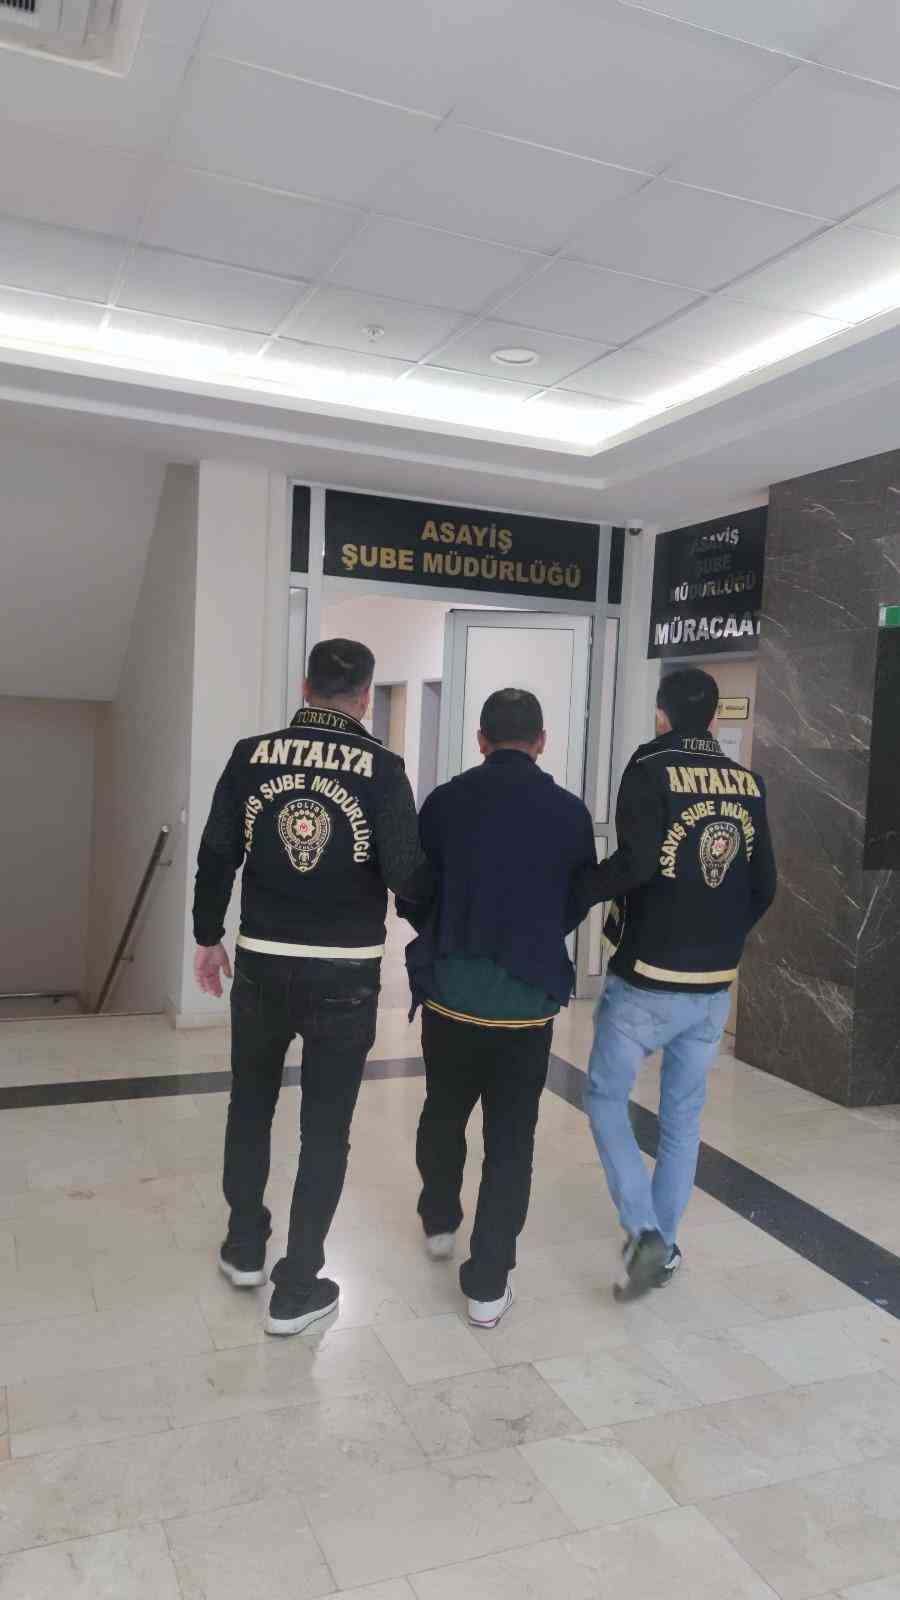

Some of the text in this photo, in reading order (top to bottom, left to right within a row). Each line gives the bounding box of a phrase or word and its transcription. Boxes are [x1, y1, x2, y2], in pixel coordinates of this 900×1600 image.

[420, 520, 513, 554] ASAYİŞ
[341, 543, 582, 588] ŞUBE MÜDÜRLÜĞÜ
[295, 710, 348, 730] TÜRKİYE
[250, 739, 374, 778] ANTALYA
[666, 767, 761, 798] ANTALYA
[259, 773, 306, 802] ŞUBE
[310, 775, 372, 863] MÜDÜRLÜĞÜ
[659, 822, 688, 878] ASAYİŞ
[681, 800, 716, 828] ŞUBE
